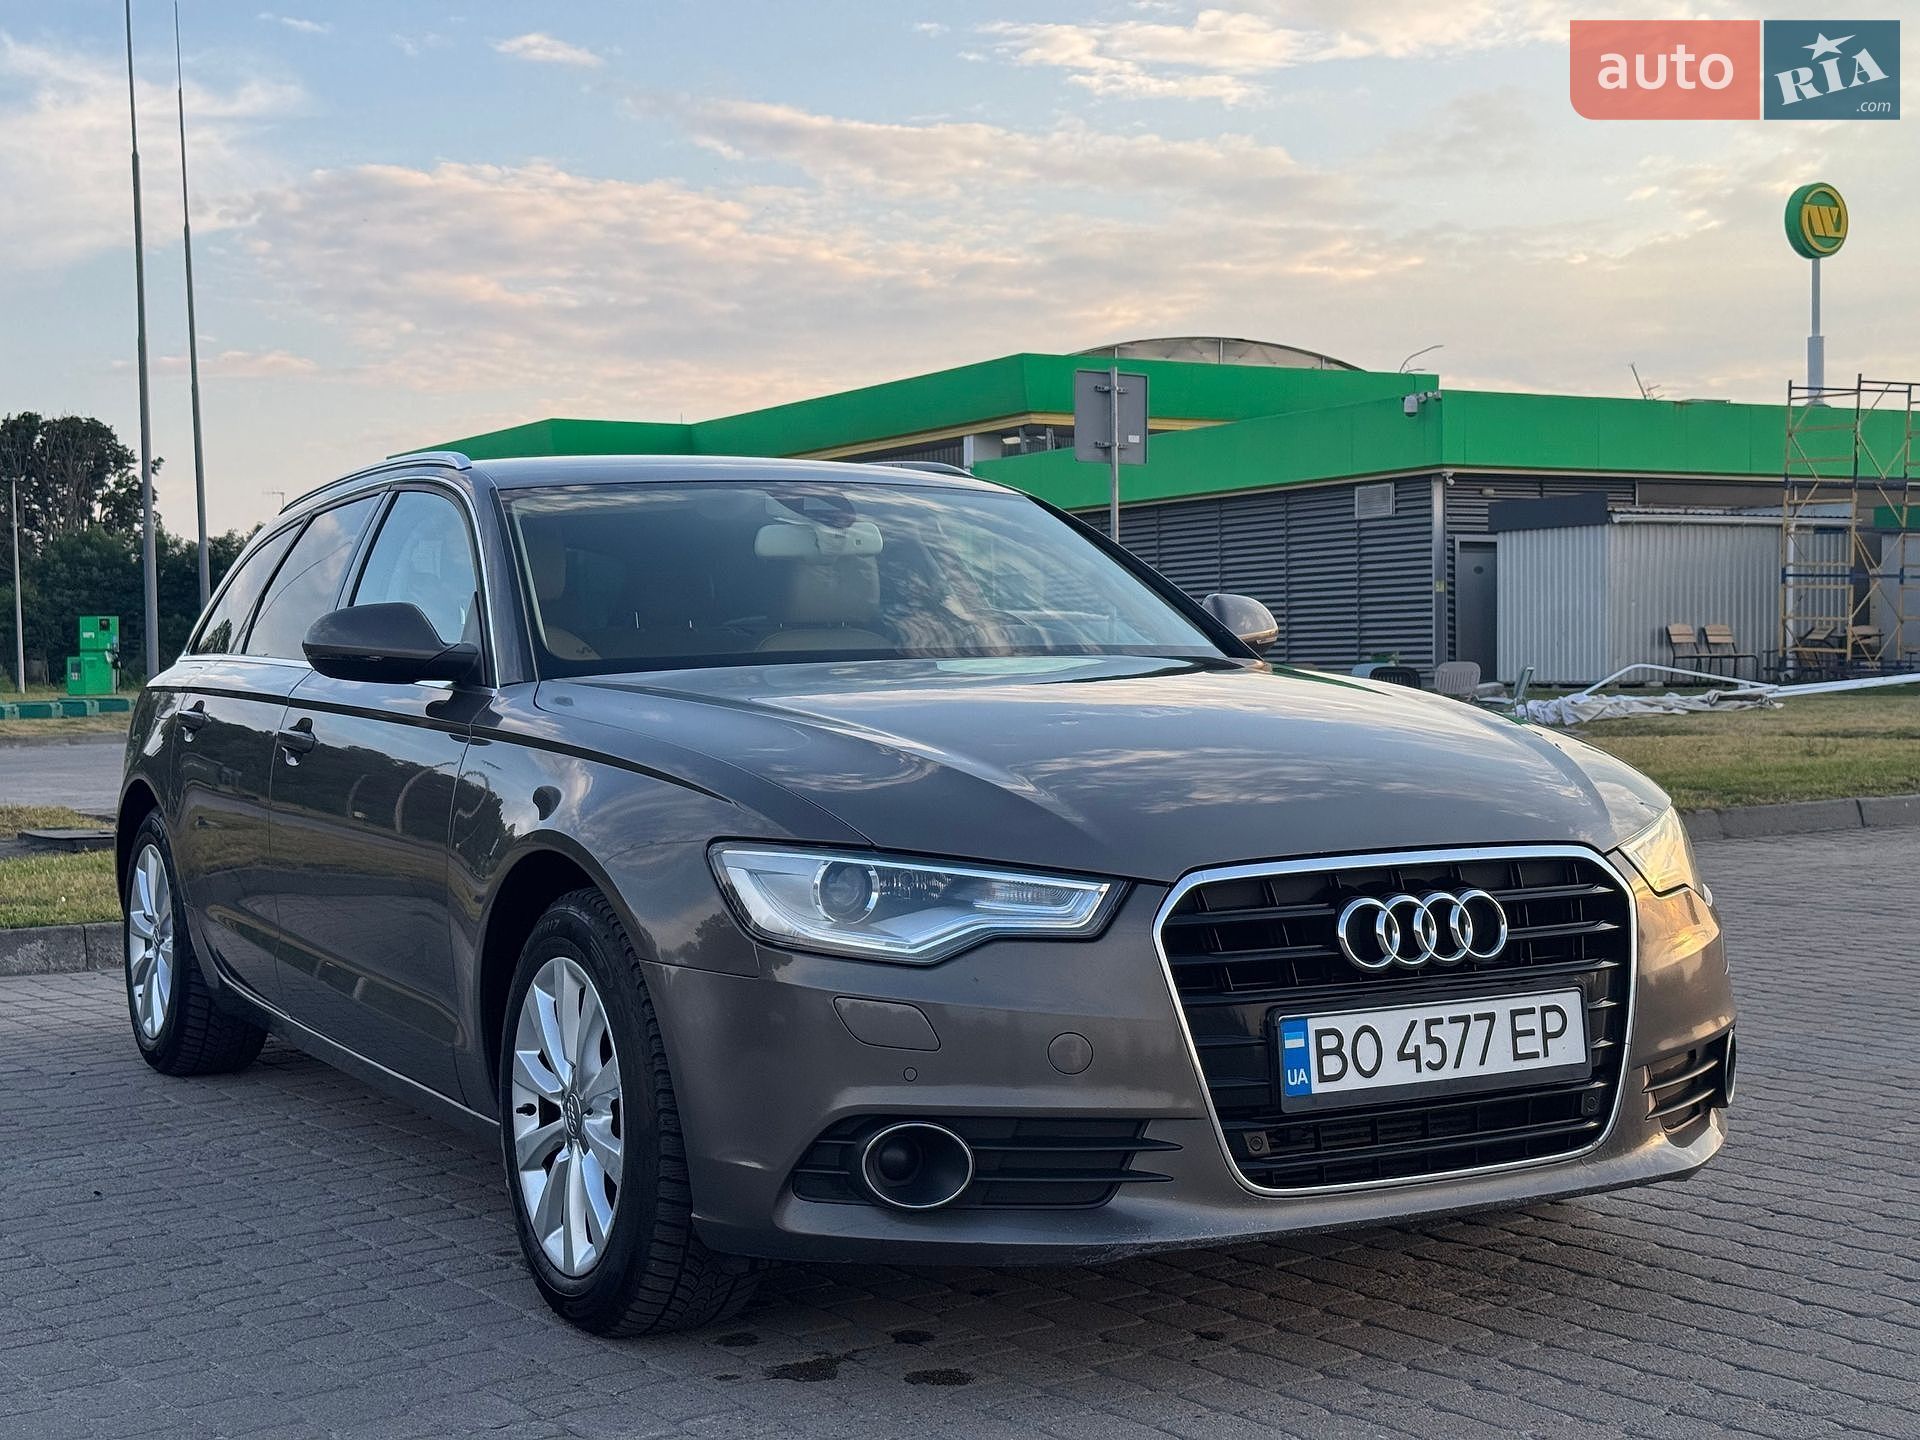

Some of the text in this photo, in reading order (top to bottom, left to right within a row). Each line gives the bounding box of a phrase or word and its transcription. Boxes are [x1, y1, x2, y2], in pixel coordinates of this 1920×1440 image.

[1314, 1004, 1568, 1084] BO 4577 EP
[1287, 1068, 1309, 1086] UA
